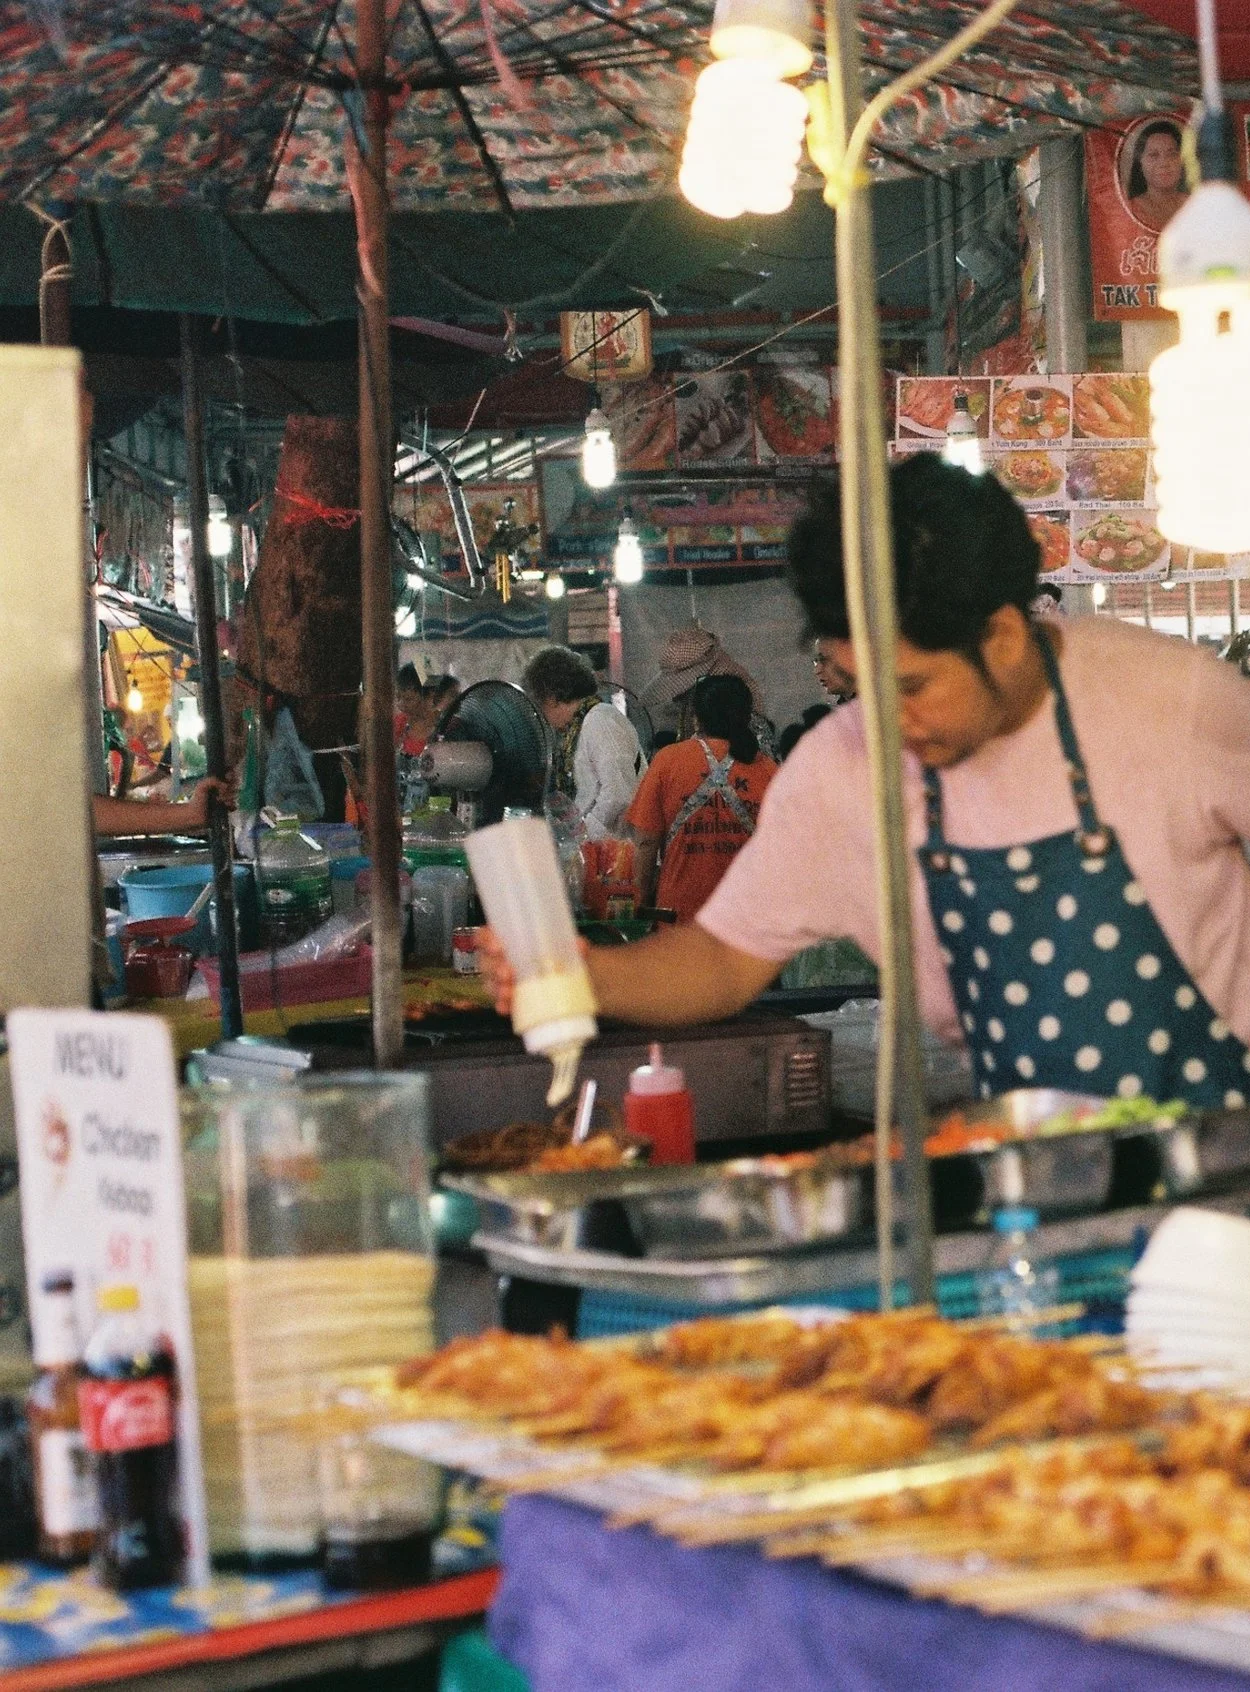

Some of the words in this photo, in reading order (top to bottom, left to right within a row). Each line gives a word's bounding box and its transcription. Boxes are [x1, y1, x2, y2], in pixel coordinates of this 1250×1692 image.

[1101, 284, 1141, 308] TAK
[1144, 283, 1159, 307] T
[54, 1031, 130, 1080] MENU
[82, 1111, 162, 1163] Chicken
